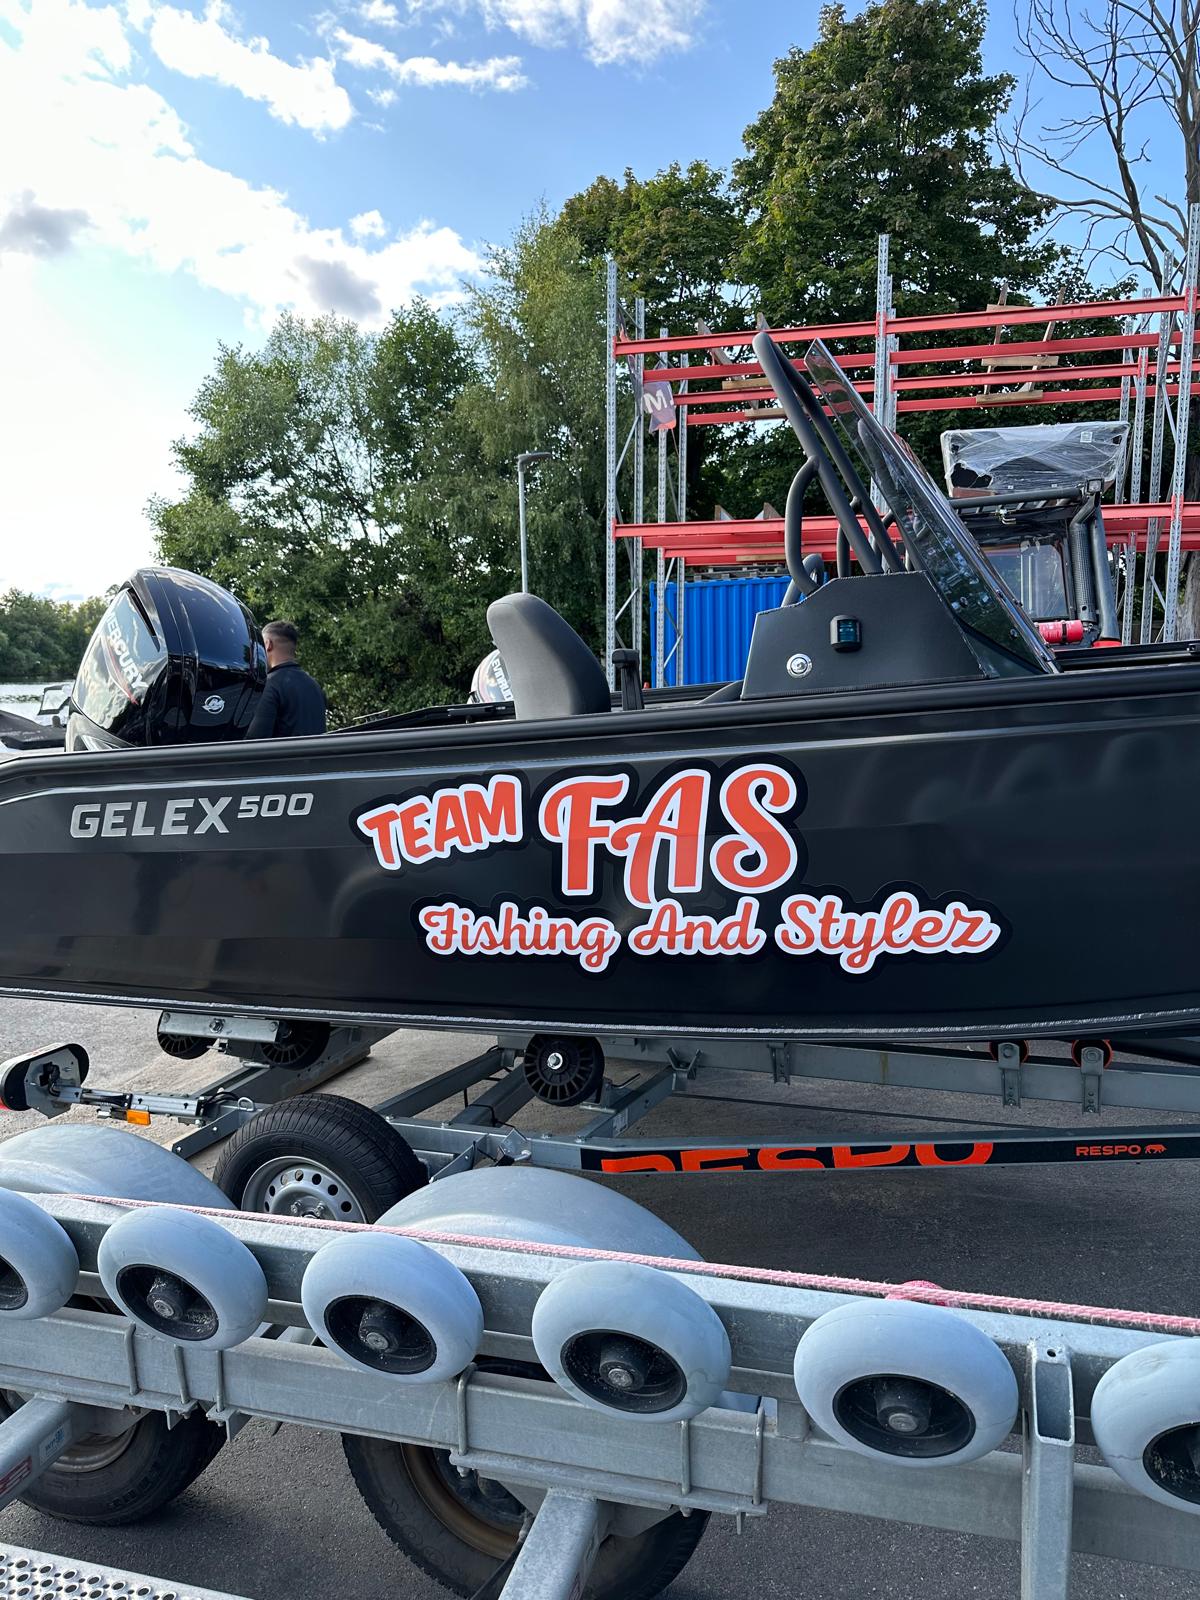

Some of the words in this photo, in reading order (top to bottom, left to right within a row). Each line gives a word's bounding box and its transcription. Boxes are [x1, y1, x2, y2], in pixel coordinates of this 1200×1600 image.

[69, 796, 233, 839] GELEX
[236, 792, 314, 819] 500
[357, 773, 523, 871] TEAM
[538, 763, 798, 910] FAS
[419, 901, 622, 973] Fishing
[628, 896, 768, 956] And
[774, 891, 1001, 974] Stylez
[1075, 1144, 1142, 1157] RESPO
